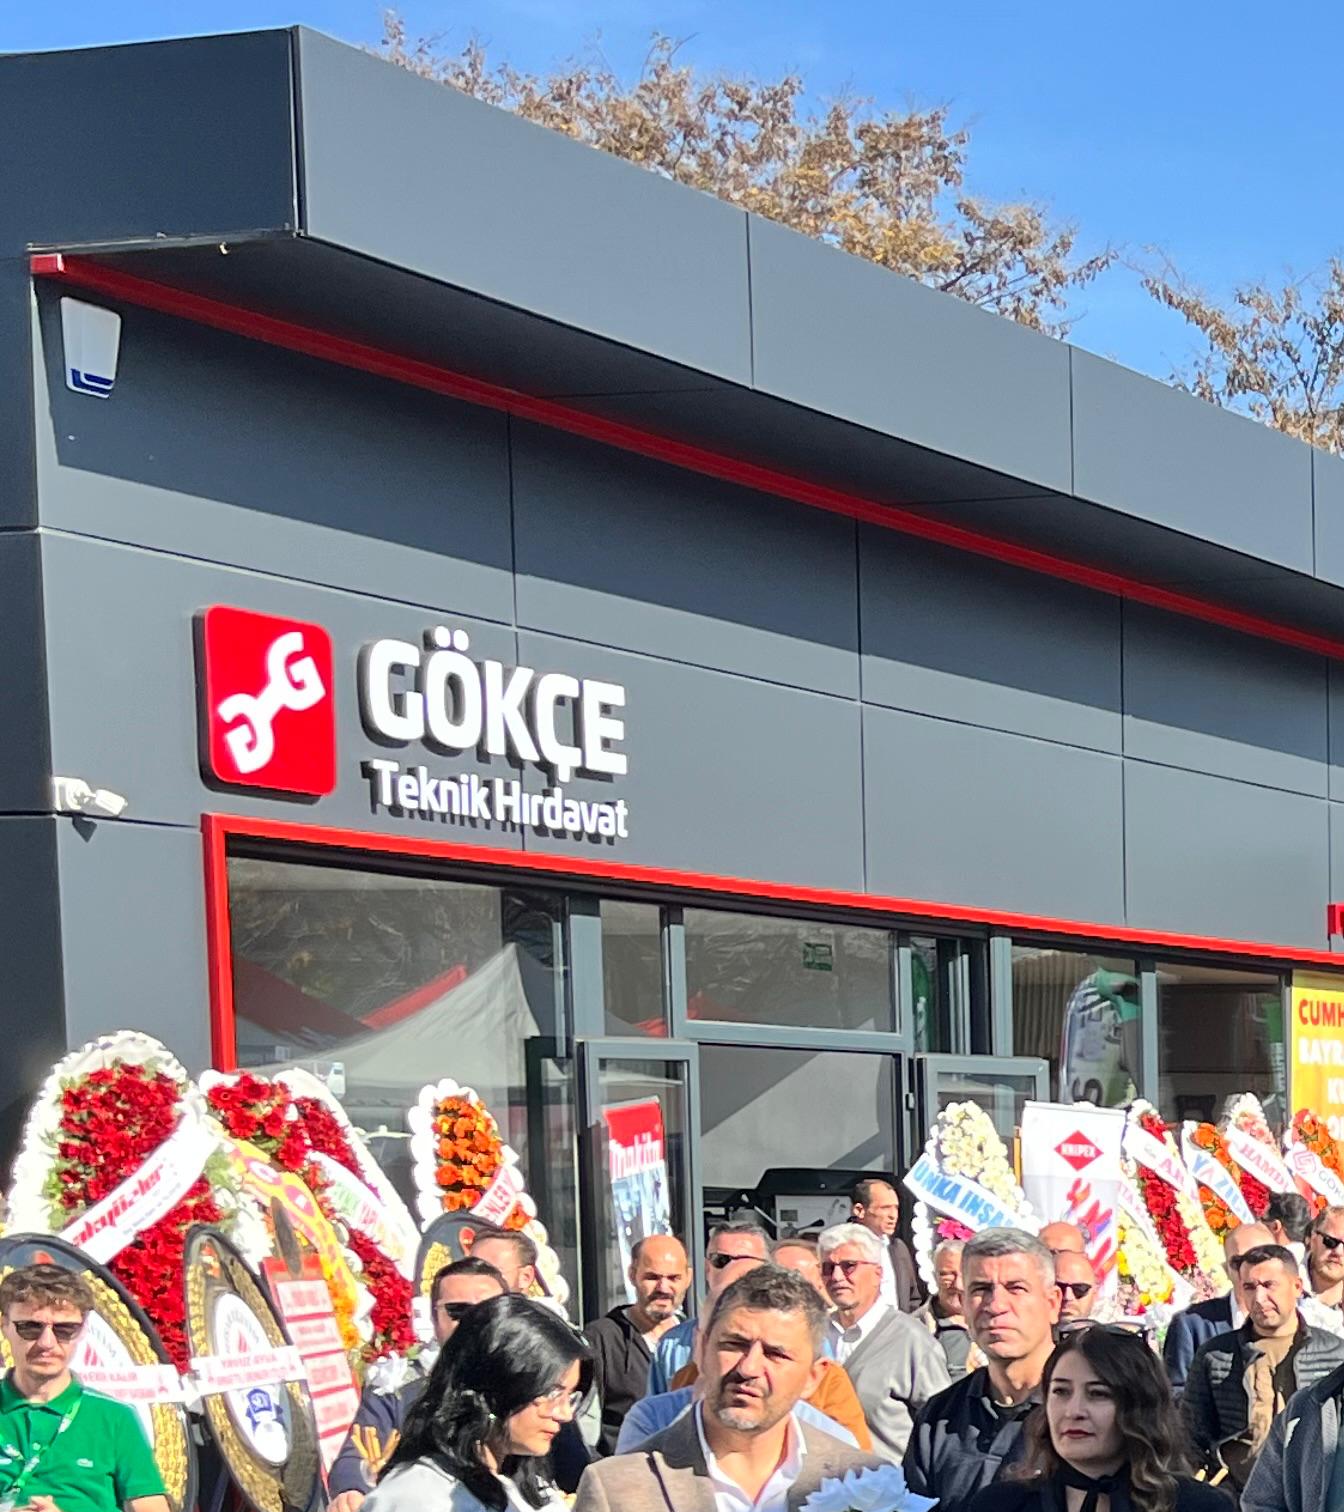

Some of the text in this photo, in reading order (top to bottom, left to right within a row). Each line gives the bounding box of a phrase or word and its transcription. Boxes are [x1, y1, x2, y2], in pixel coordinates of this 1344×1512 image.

[367, 626, 628, 783] GÖKÇE
[371, 758, 629, 838] Teknik Hırdavat
